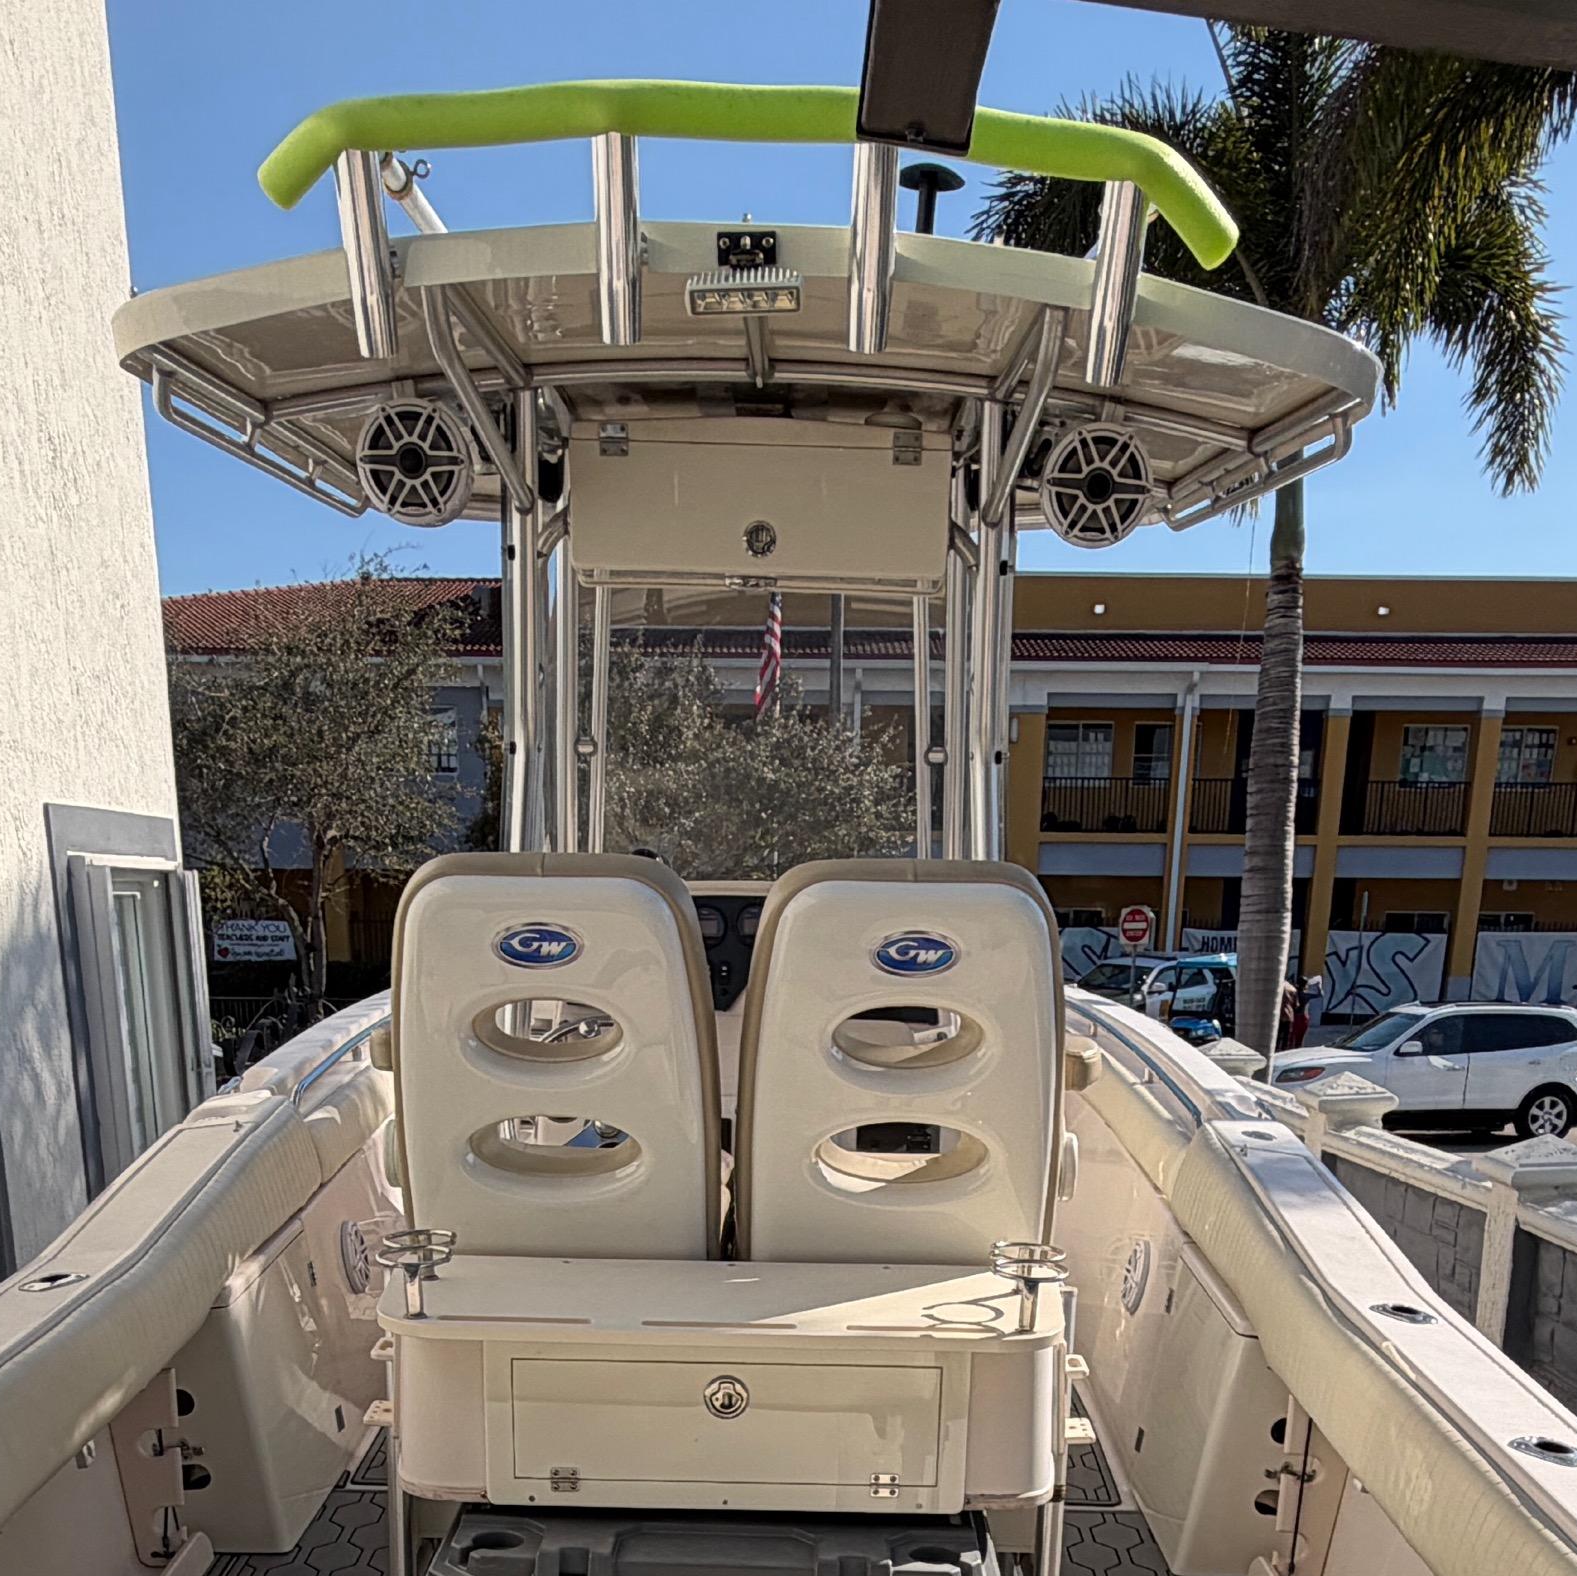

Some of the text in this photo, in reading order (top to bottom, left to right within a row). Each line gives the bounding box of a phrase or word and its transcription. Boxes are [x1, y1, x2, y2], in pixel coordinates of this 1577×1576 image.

[260, 922, 288, 934] YOU
[510, 933, 568, 957] GW
[887, 941, 946, 964] GW
